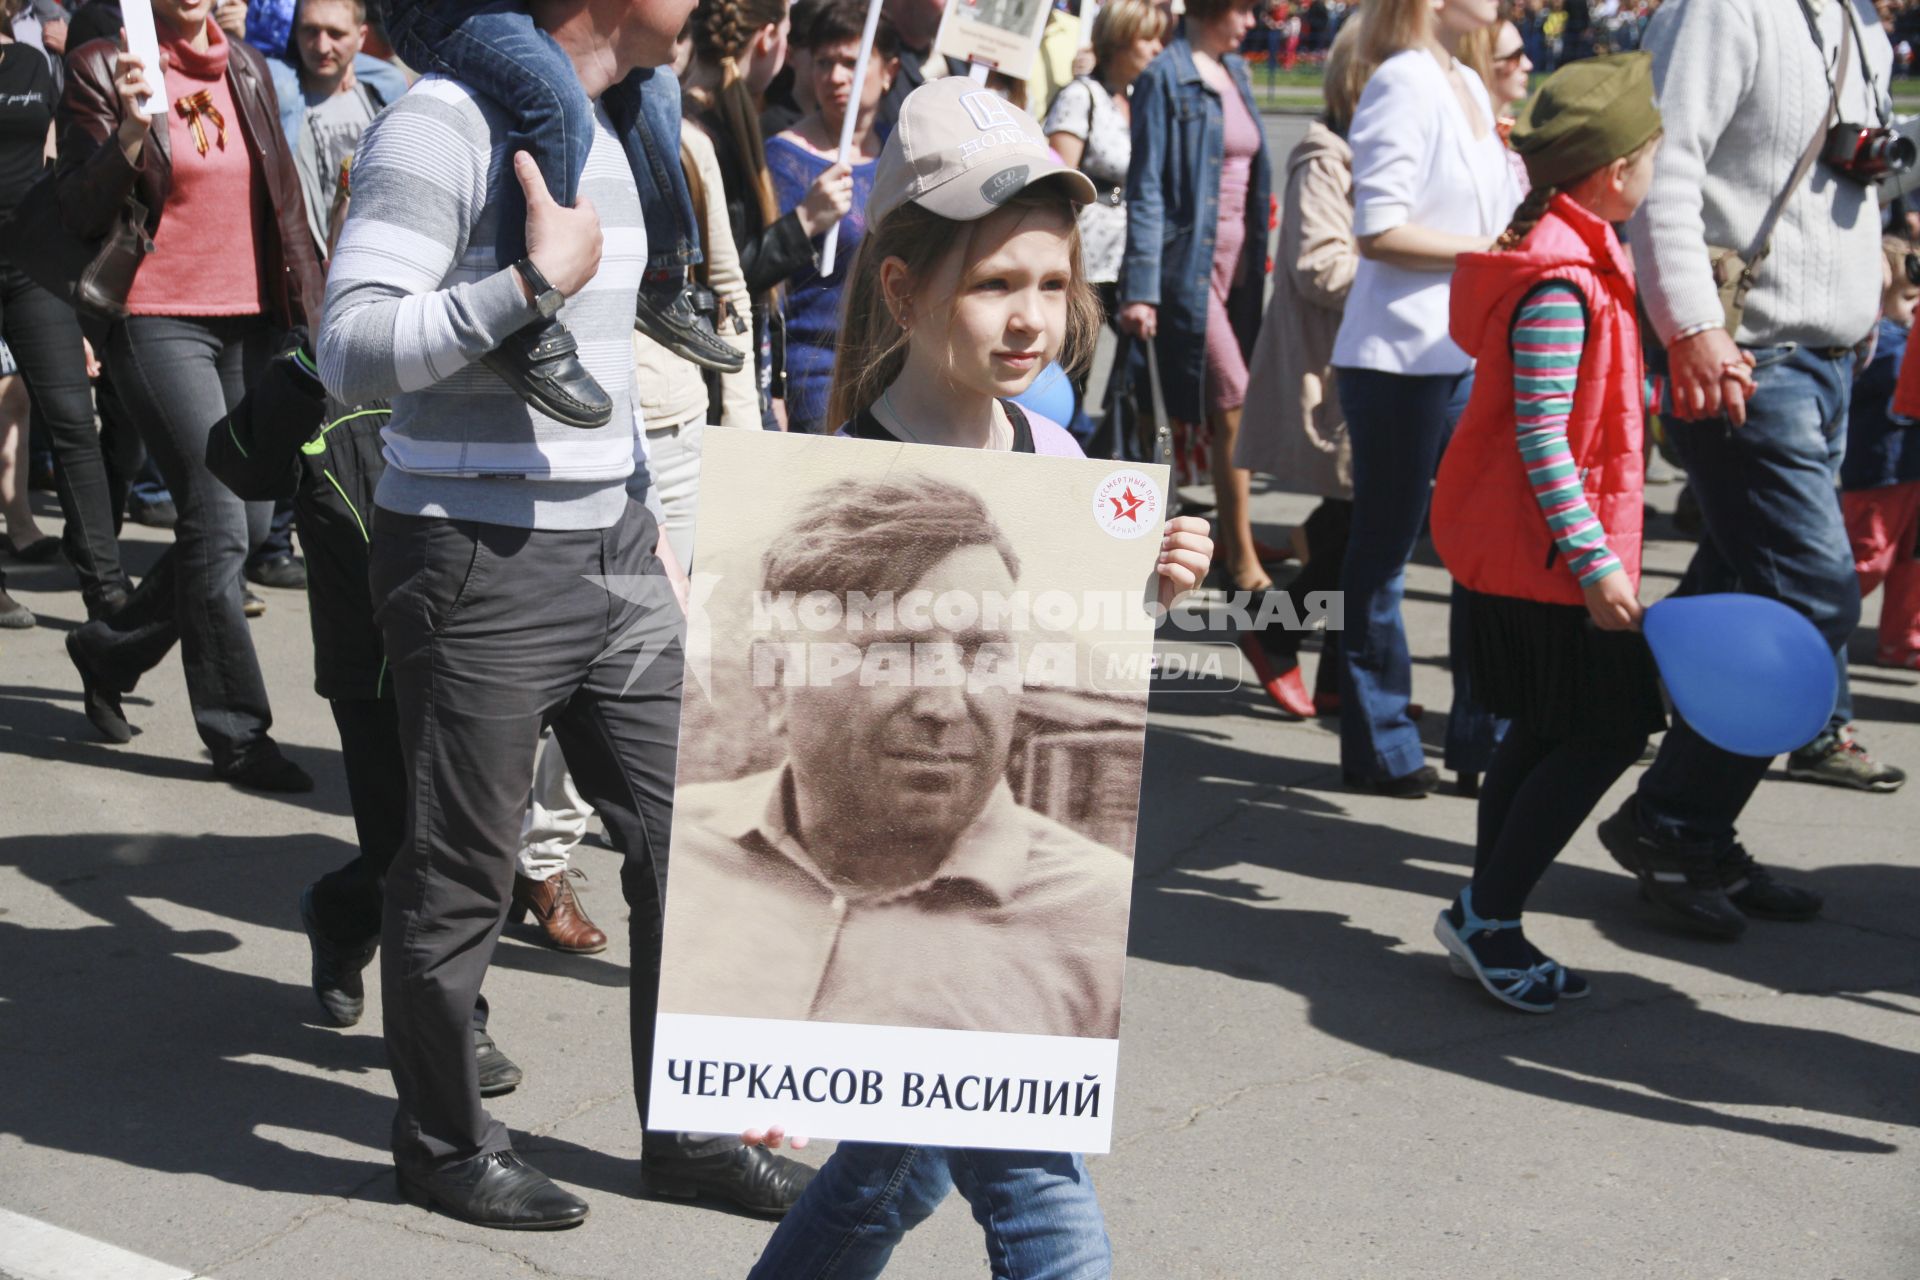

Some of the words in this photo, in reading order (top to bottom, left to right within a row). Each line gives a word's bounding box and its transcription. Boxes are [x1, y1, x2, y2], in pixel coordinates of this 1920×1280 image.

[1098, 476, 1147, 508] БЕССМЕРТНЫЙ
[1146, 489, 1156, 512] ПОЛК
[667, 1058, 884, 1105] ЧЕРКАСОВ
[901, 1072, 1102, 1118] ВАСИЛИЙ
